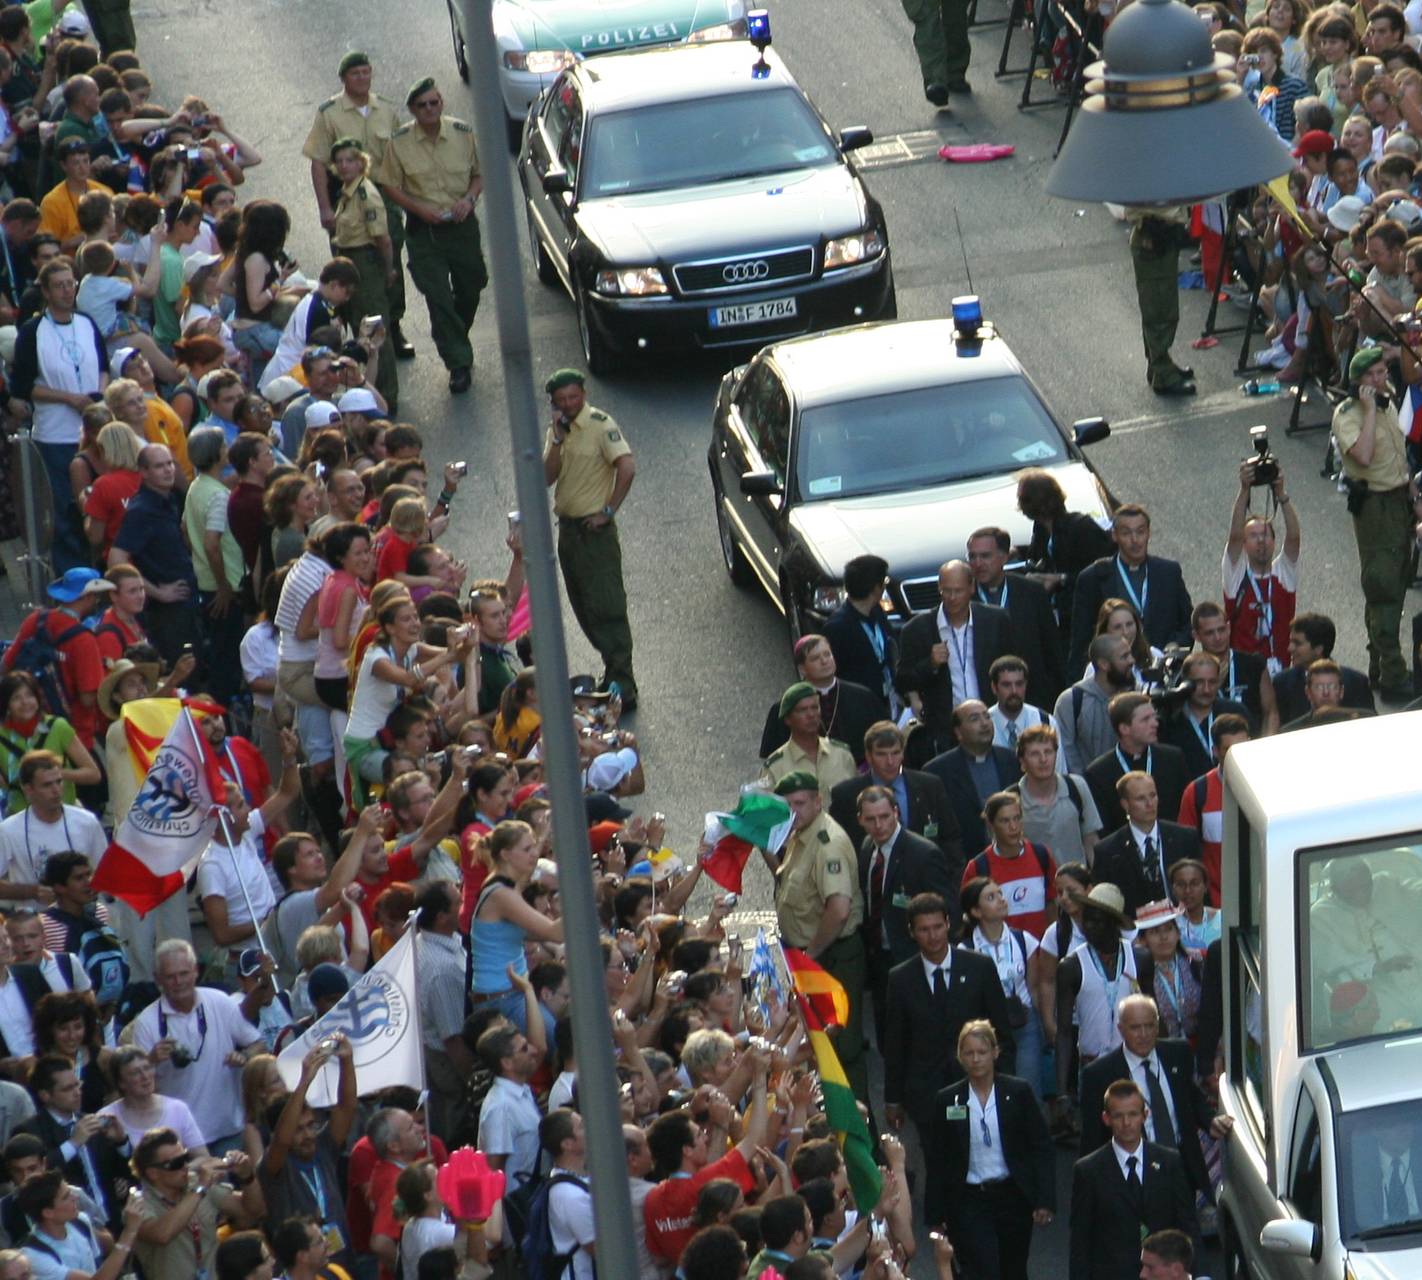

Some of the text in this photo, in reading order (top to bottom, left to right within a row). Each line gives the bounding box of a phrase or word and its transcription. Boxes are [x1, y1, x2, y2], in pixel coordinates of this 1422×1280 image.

[581, 22, 678, 48] POLIZEI
[720, 300, 793, 323] IN F 1784
